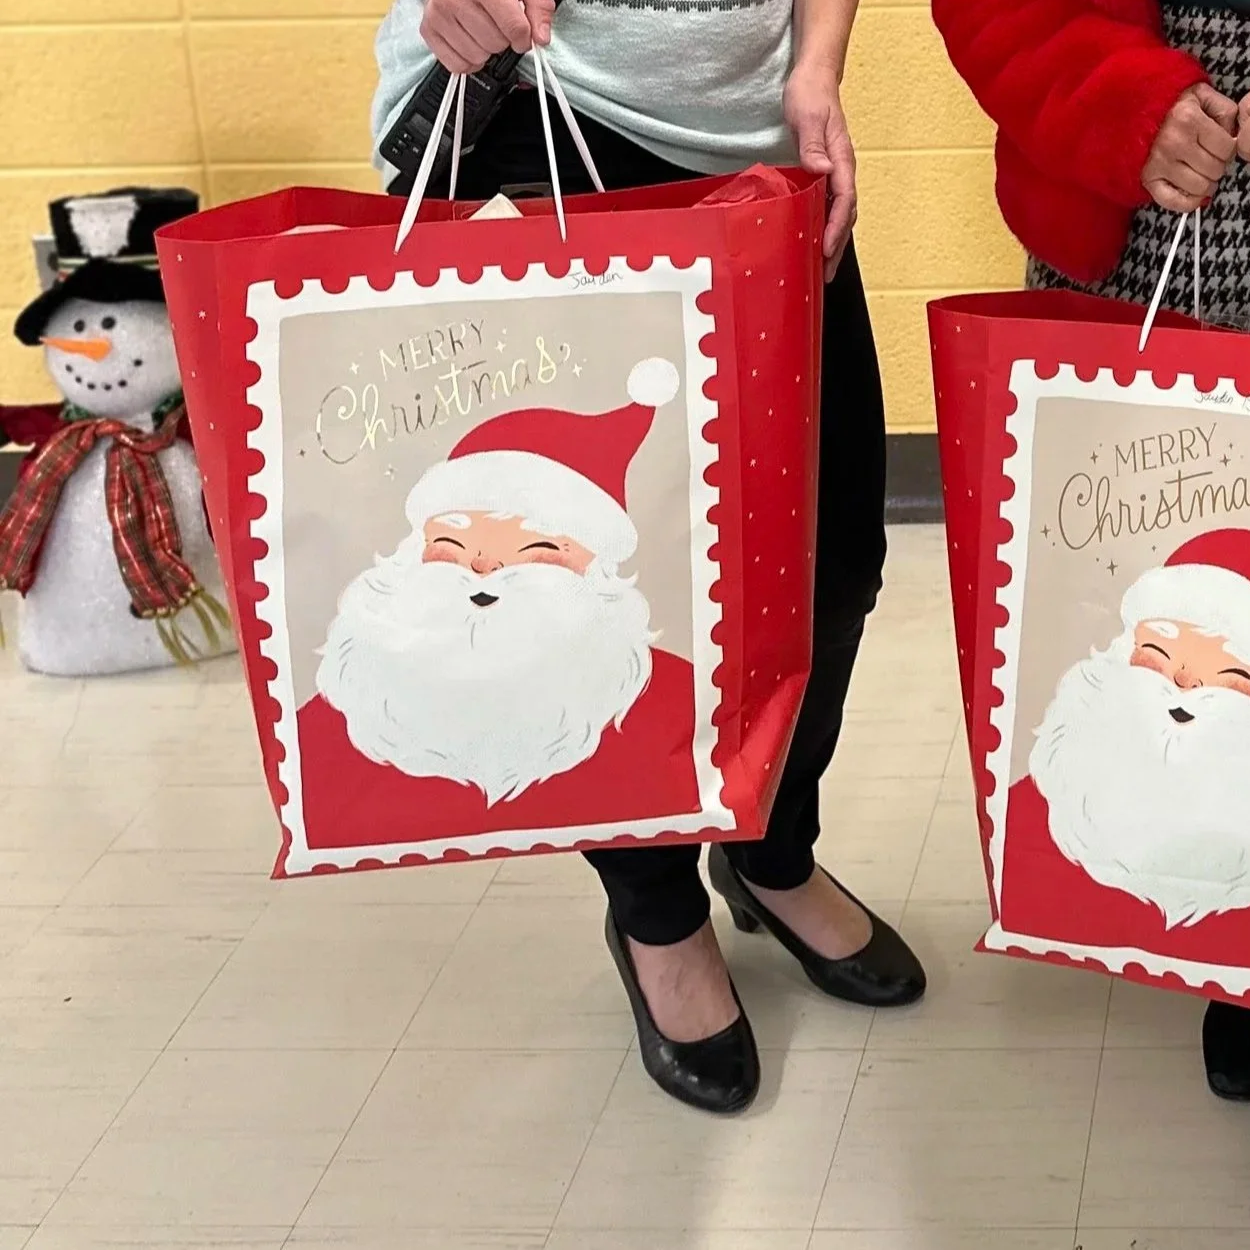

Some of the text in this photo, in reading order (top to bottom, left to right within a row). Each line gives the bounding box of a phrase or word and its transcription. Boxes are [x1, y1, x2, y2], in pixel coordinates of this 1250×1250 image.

[379, 318, 487, 381] MERRY
[315, 336, 572, 465] Christmas
[1115, 422, 1218, 477] MERRY
